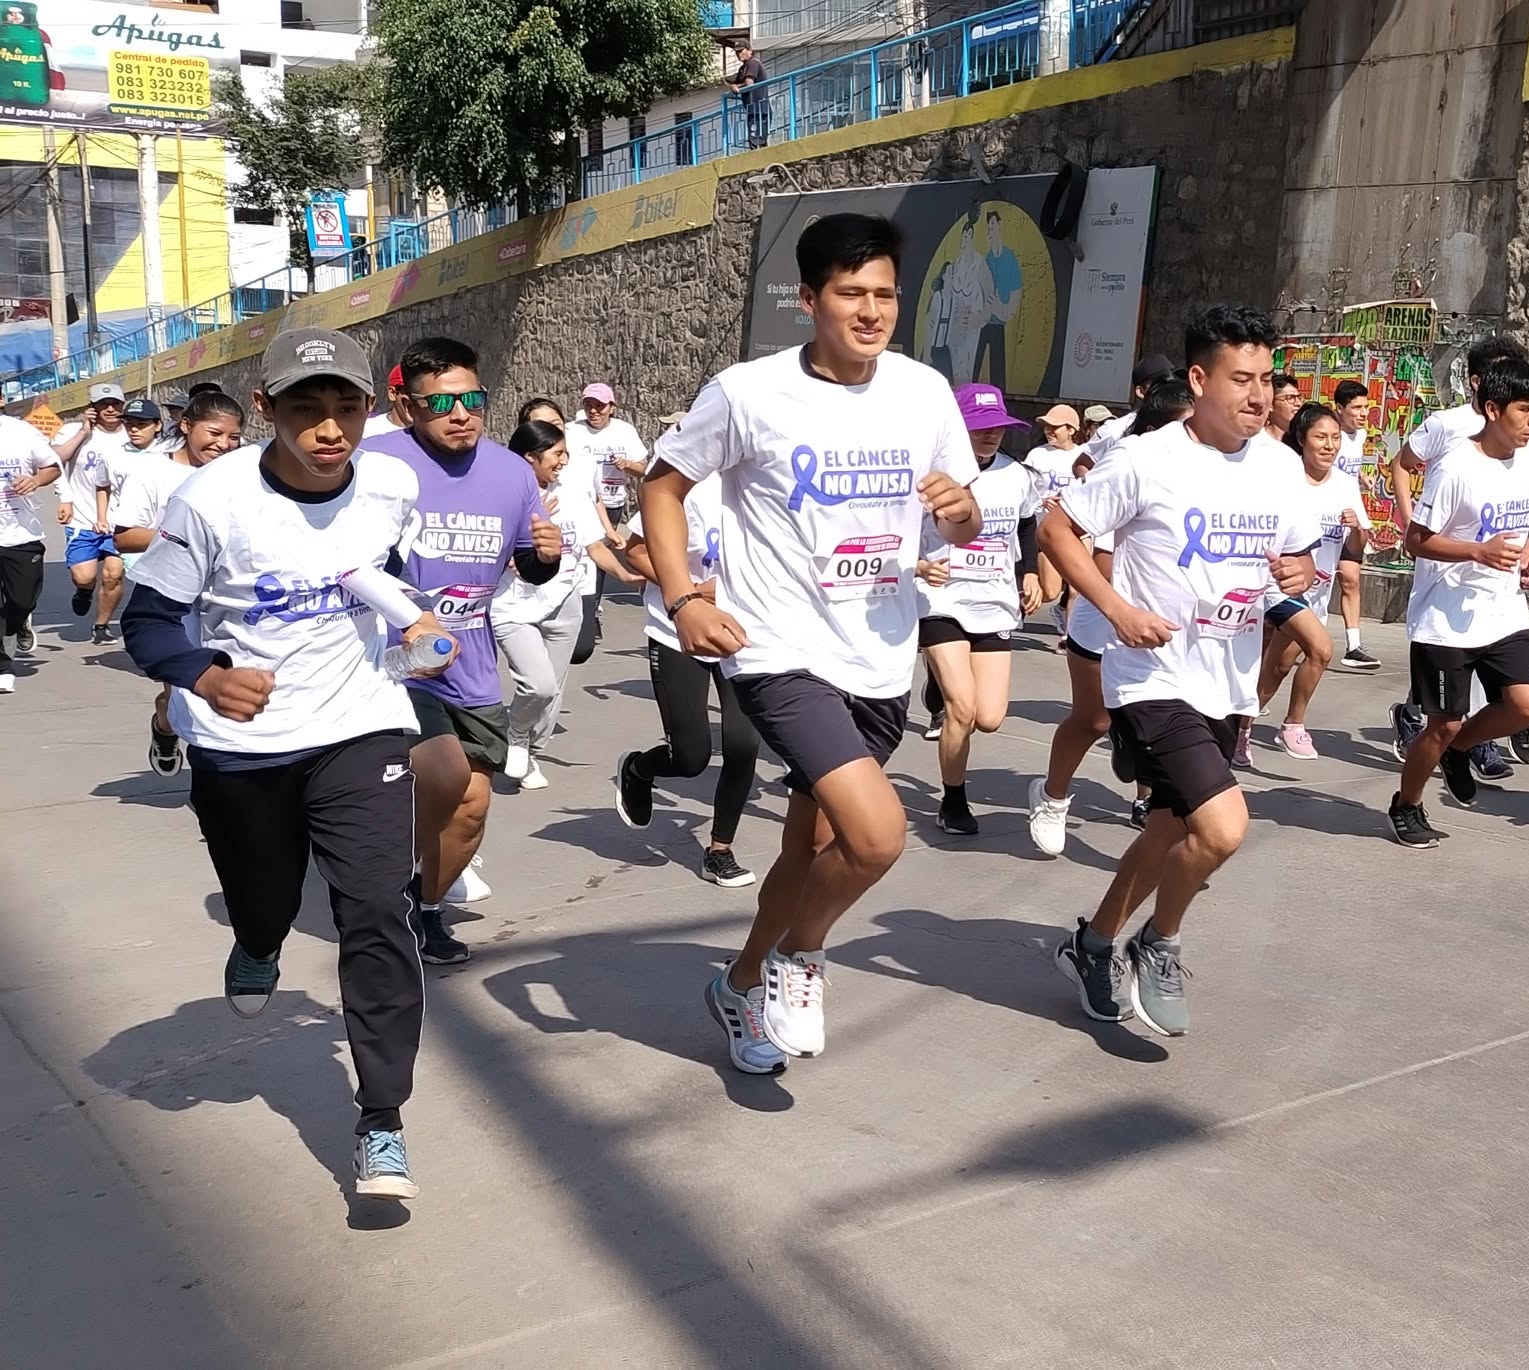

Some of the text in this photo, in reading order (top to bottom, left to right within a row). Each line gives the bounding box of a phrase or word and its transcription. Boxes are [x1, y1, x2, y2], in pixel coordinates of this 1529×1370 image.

[114, 51, 205, 68] Central de pedido
[115, 62, 204, 81] 981 730 607
[117, 75, 203, 94] 083 323232
[117, 88, 205, 106] 083 323015
[1384, 306, 1433, 327] ARENAS
[1391, 327, 1431, 342] AZURIN
[301, 355, 316, 363] NEW
[824, 450, 843, 468] EL
[824, 472, 910, 496] NO AVISA
[425, 511, 503, 532] EL CÁNCER
[983, 507, 1015, 518] ANCER
[1211, 513, 1225, 529] EL
[426, 532, 501, 553] NO AVISA
[1210, 535, 1232, 554] NO
[836, 557, 883, 578] 009
[965, 553, 996, 567] 001
[439, 600, 480, 616] 044
[1217, 604, 1254, 623] 01
[386, 764, 404, 775] NIKE
